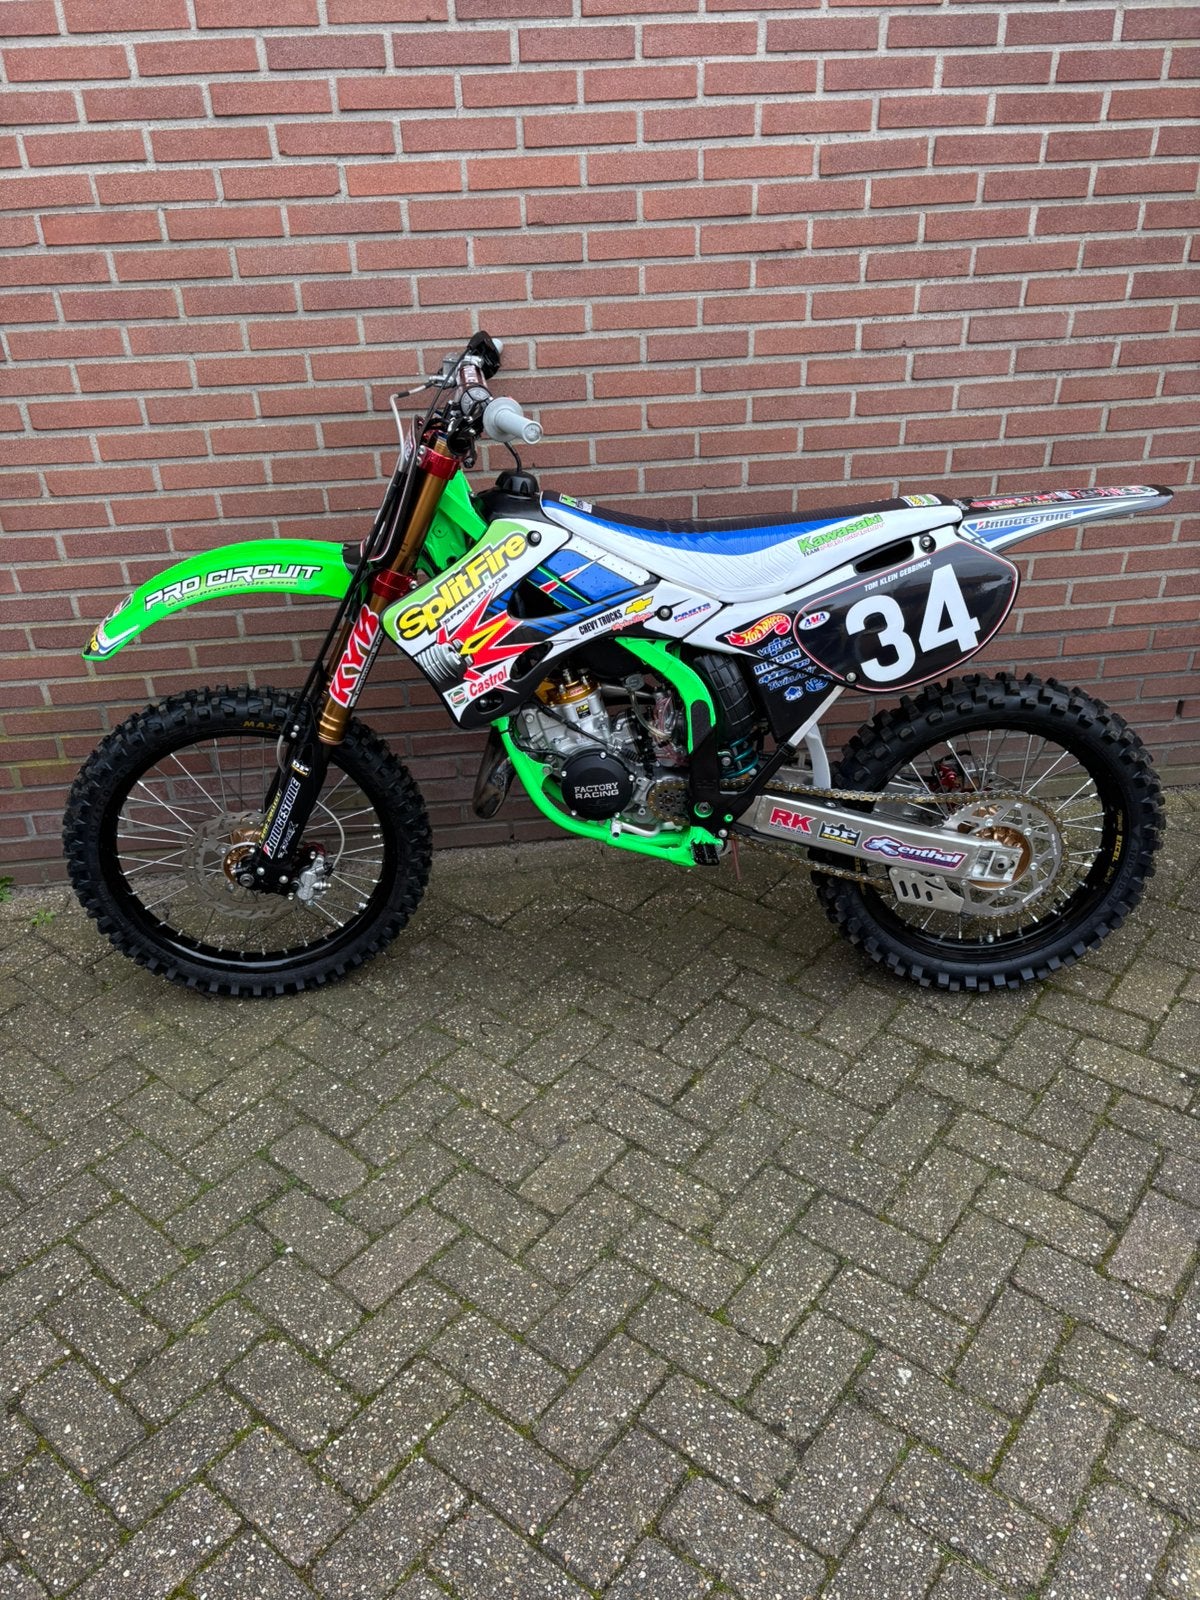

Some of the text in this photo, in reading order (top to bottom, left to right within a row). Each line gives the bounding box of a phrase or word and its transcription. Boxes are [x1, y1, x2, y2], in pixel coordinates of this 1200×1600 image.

[797, 513, 883, 554] Kawasaki
[975, 511, 1073, 532] BRIDGESTONE
[803, 547, 820, 557] TEAM
[144, 564, 322, 611] PRO CIRCUIT
[398, 533, 526, 639] SplitFire
[864, 580, 880, 592] TOM
[879, 573, 899, 586] KLEIN
[443, 572, 508, 625] SPARK PLUGS
[579, 618, 600, 635] CHEVY
[599, 609, 623, 627] TRUCKS
[804, 612, 826, 628] AMA
[845, 563, 981, 683] 34
[328, 603, 380, 709] KYB
[757, 636, 793, 657] VERTEX
[469, 665, 508, 697] Castrol
[574, 782, 618, 793] FACTORY
[575, 789, 619, 799] RACING
[263, 776, 301, 859] BRIDGESTONE
[769, 807, 817, 833] RK
[824, 826, 858, 839] DP
[1112, 834, 1123, 861] EXCEL
